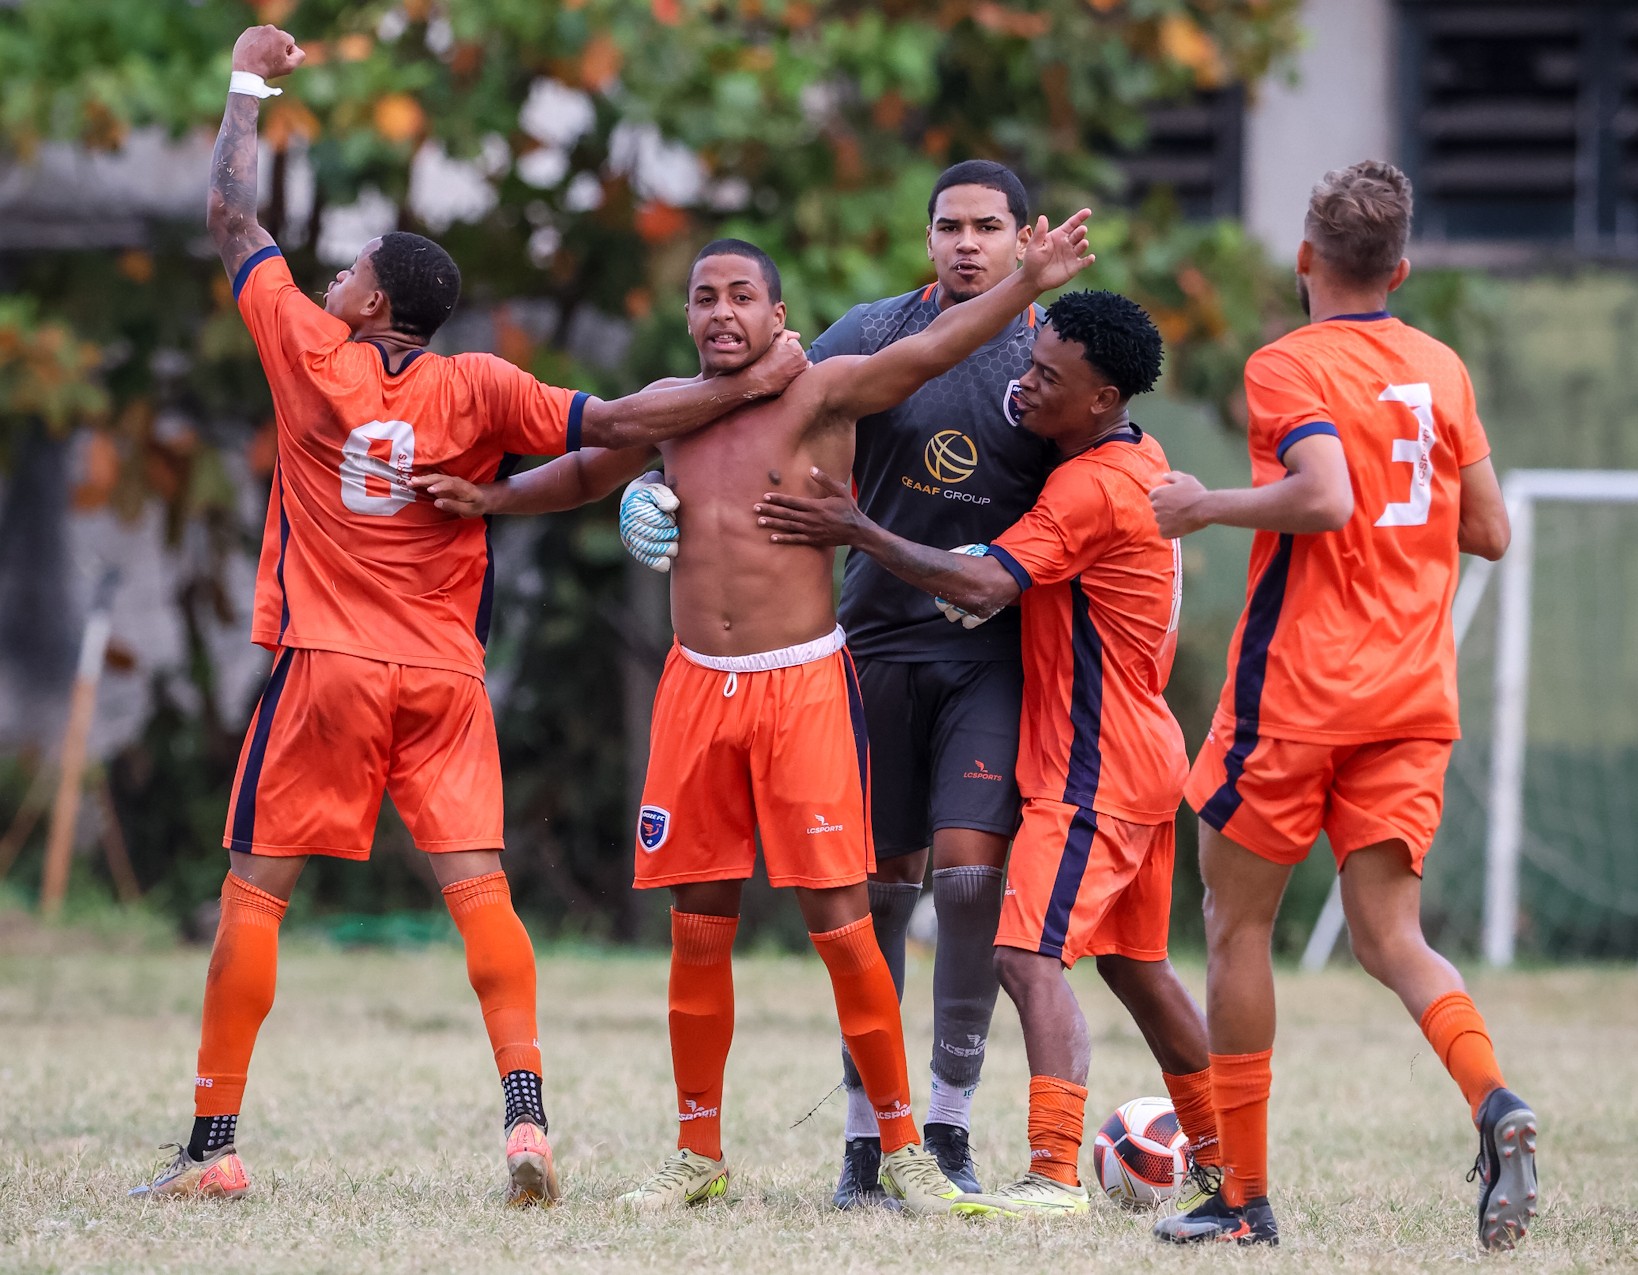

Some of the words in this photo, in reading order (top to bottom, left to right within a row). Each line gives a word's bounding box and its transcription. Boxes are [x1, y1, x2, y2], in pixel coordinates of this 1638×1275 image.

[339, 420, 416, 516] 8
[1373, 383, 1435, 527] 3
[901, 476, 941, 495] CEAAF
[943, 489, 991, 505] GROUP
[963, 771, 1003, 781] LCSPORTS
[806, 824, 843, 835] LCSPORTS
